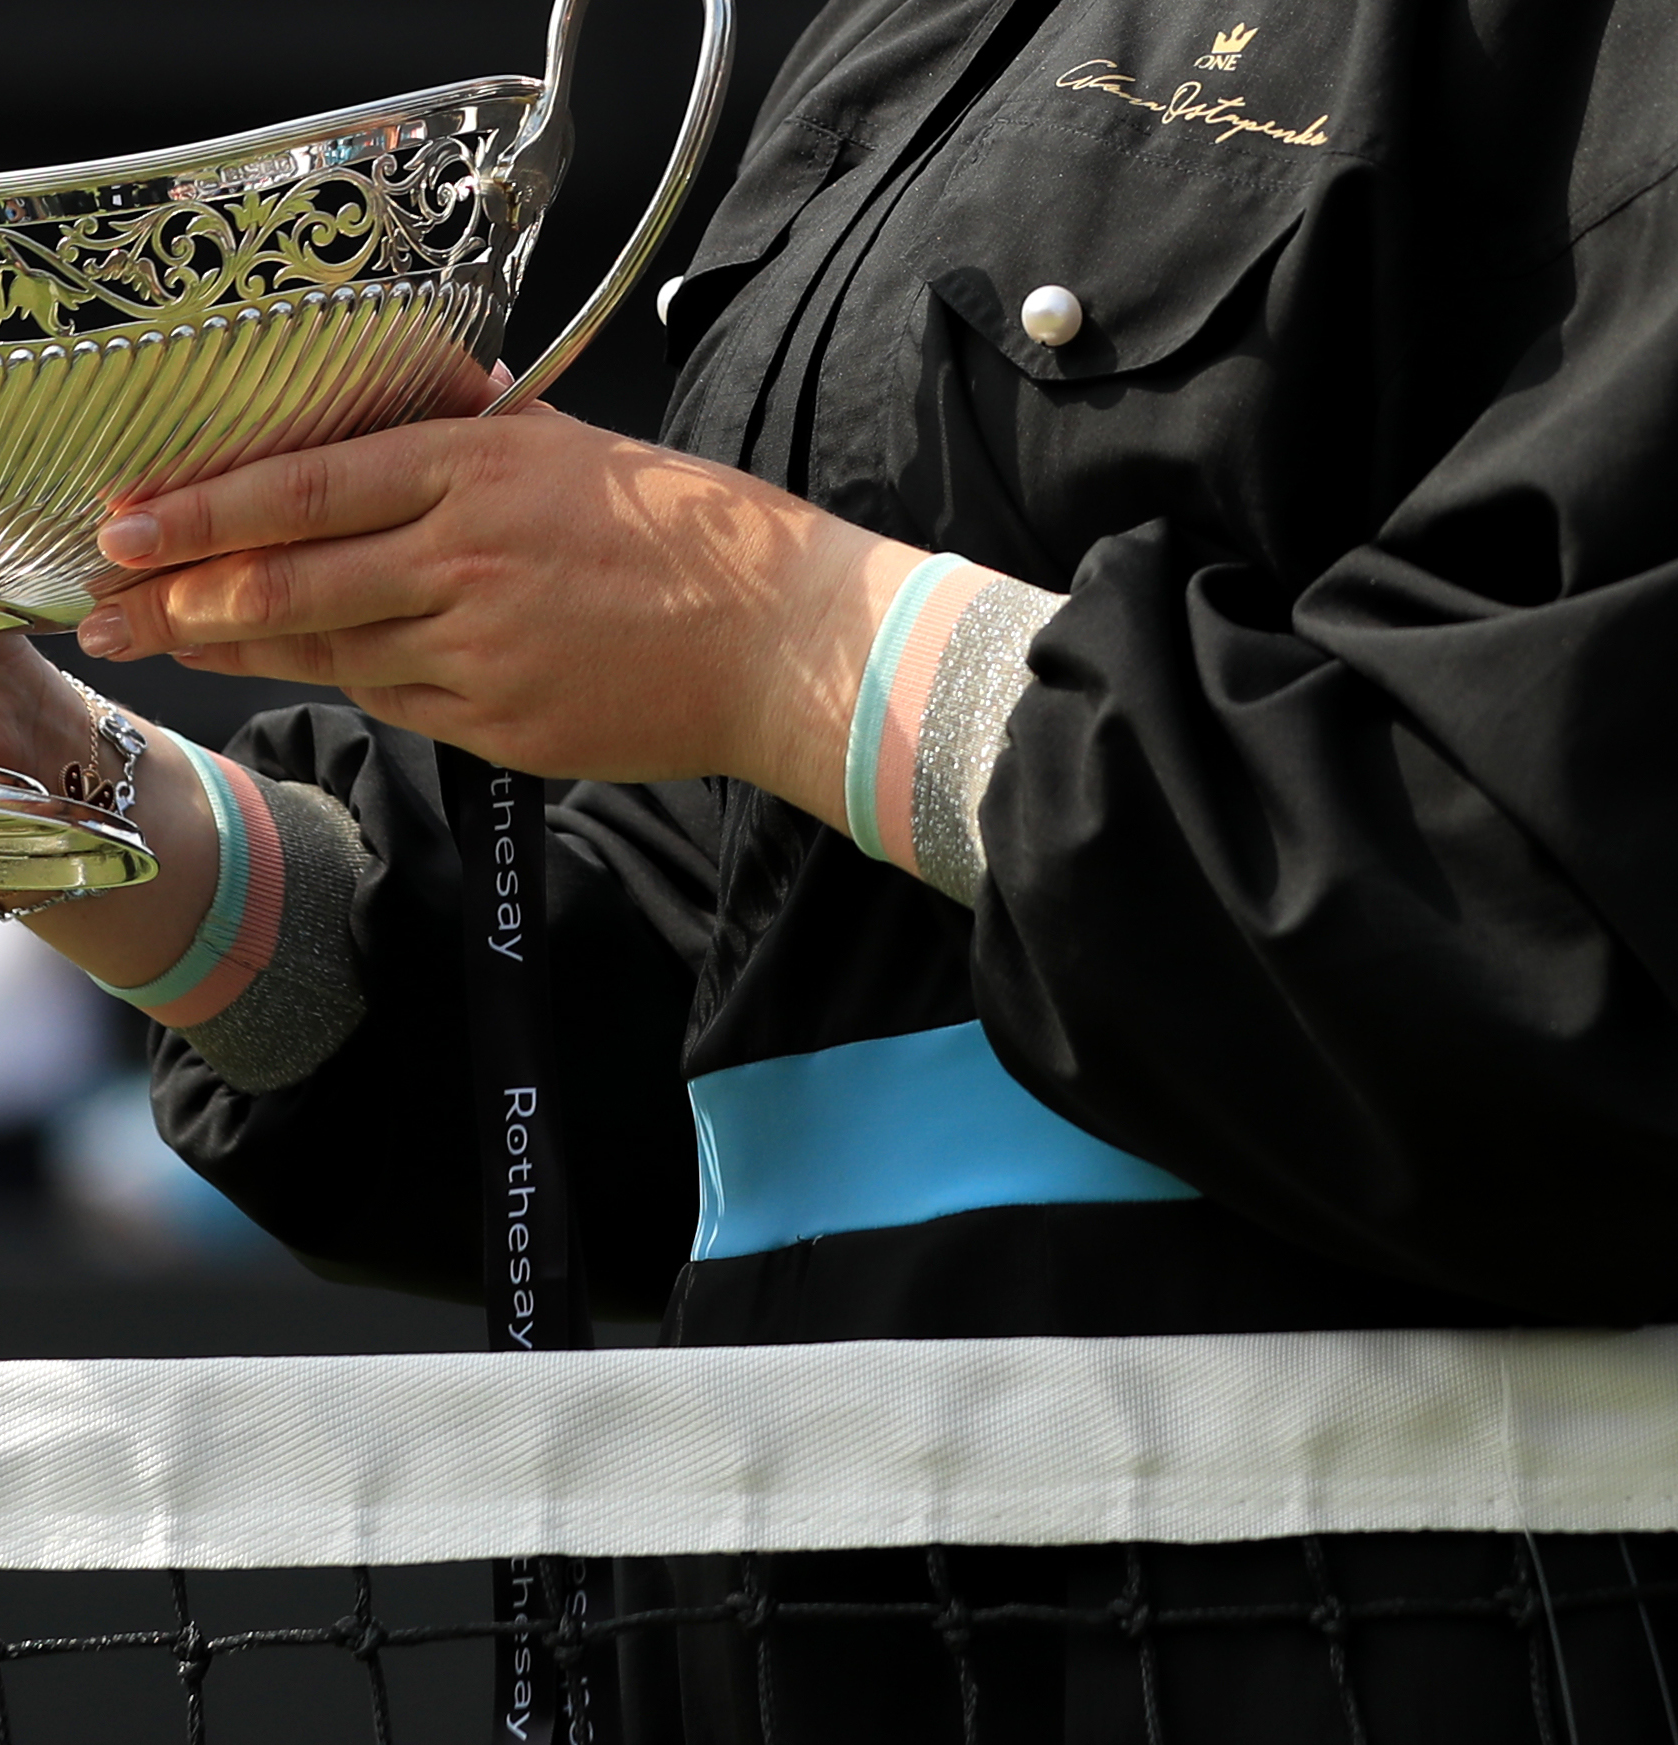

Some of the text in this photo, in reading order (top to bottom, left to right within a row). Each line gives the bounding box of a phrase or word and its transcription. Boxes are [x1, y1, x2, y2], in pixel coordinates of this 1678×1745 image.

[1193, 53, 1243, 72] ONE
[487, 763, 523, 963] thesay
[503, 1086, 538, 1349] Rothesay
